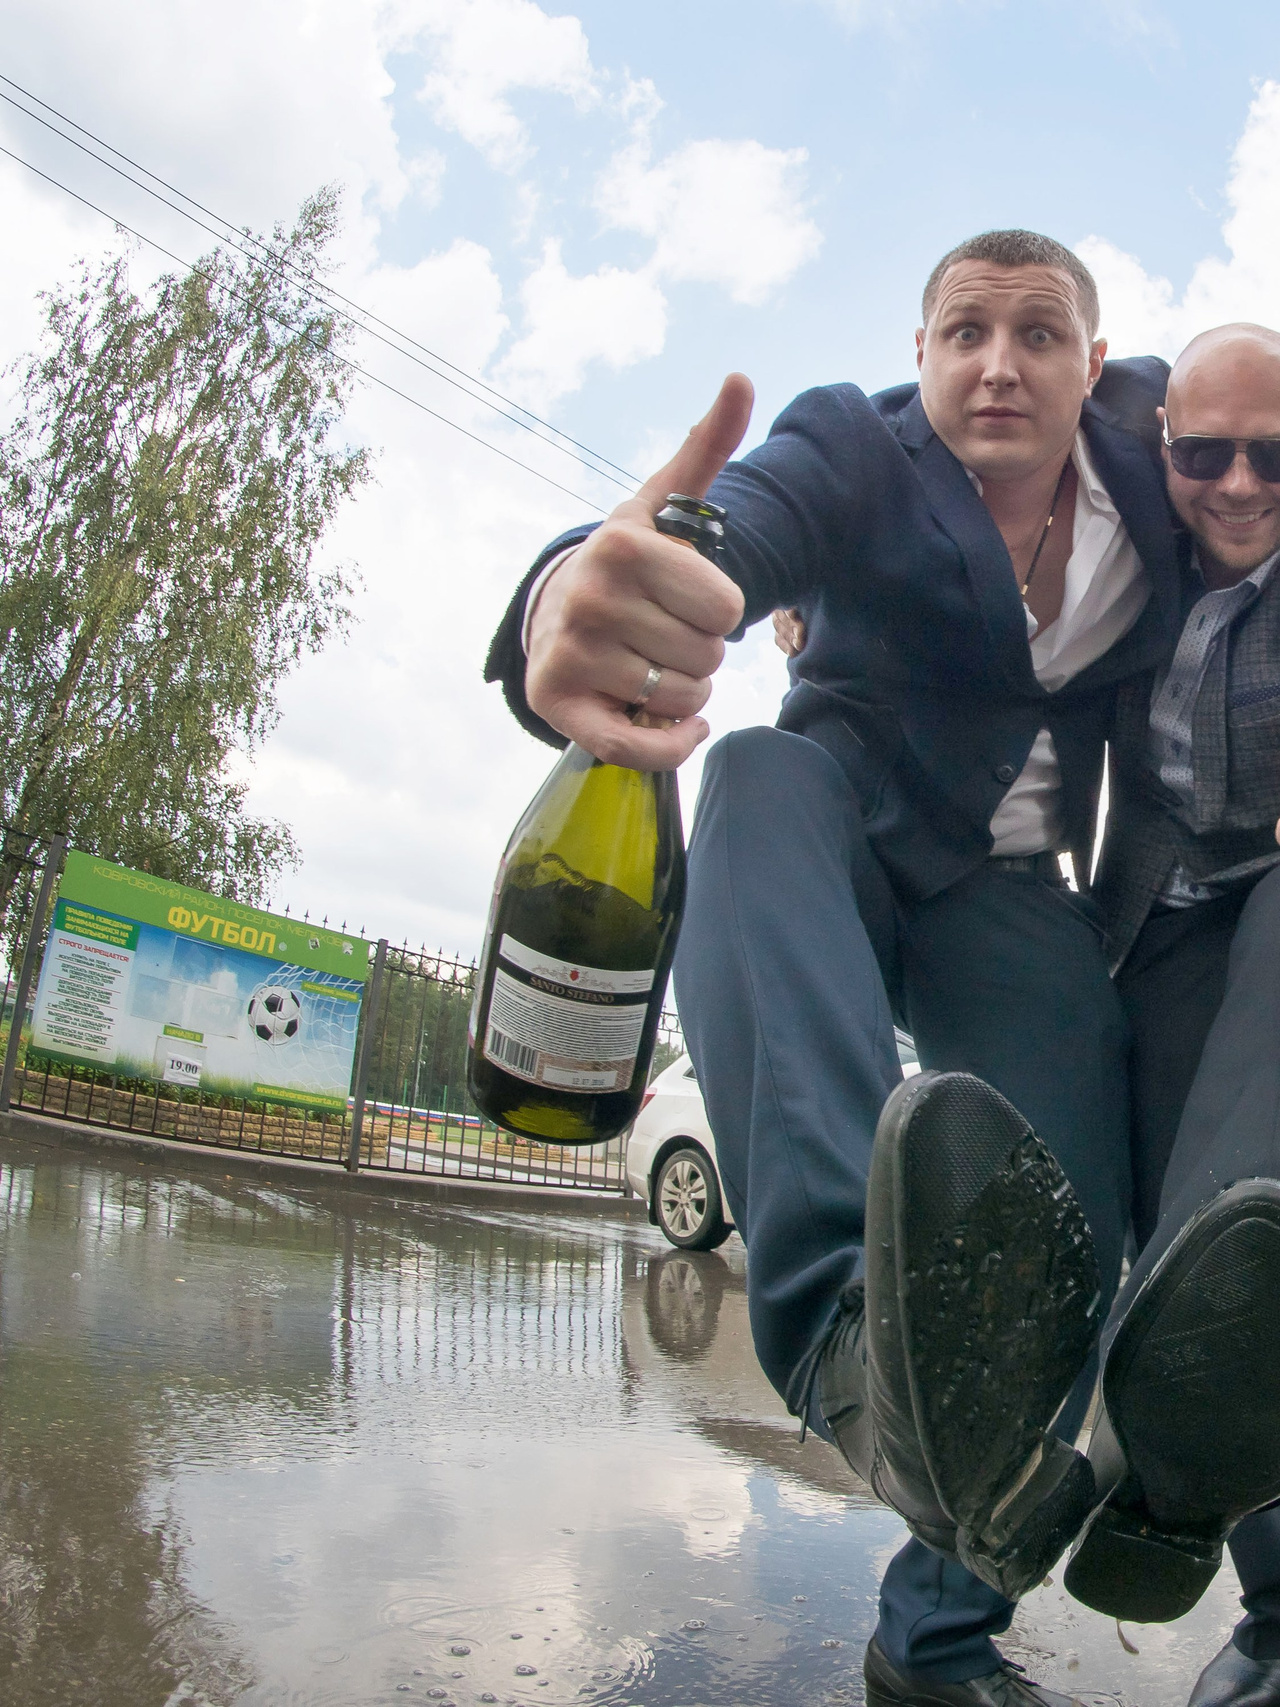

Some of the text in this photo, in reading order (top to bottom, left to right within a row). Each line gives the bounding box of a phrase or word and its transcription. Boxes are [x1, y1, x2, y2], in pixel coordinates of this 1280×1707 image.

[93, 865, 181, 899] КОВРОВСКИЙ
[228, 907, 283, 931] ПОСЕЛОК
[65, 906, 133, 931] ПРАВИЛА ПОВЕДЕНИЯ
[168, 906, 276, 954] ФУТБОЛ
[58, 938, 82, 949] СТРОГО
[64, 923, 127, 945] ФУТБОЛЬНОМ ПОЛЕ
[530, 976, 614, 1004] SANTO STEFANO
[170, 1059, 198, 1074] 19.00
